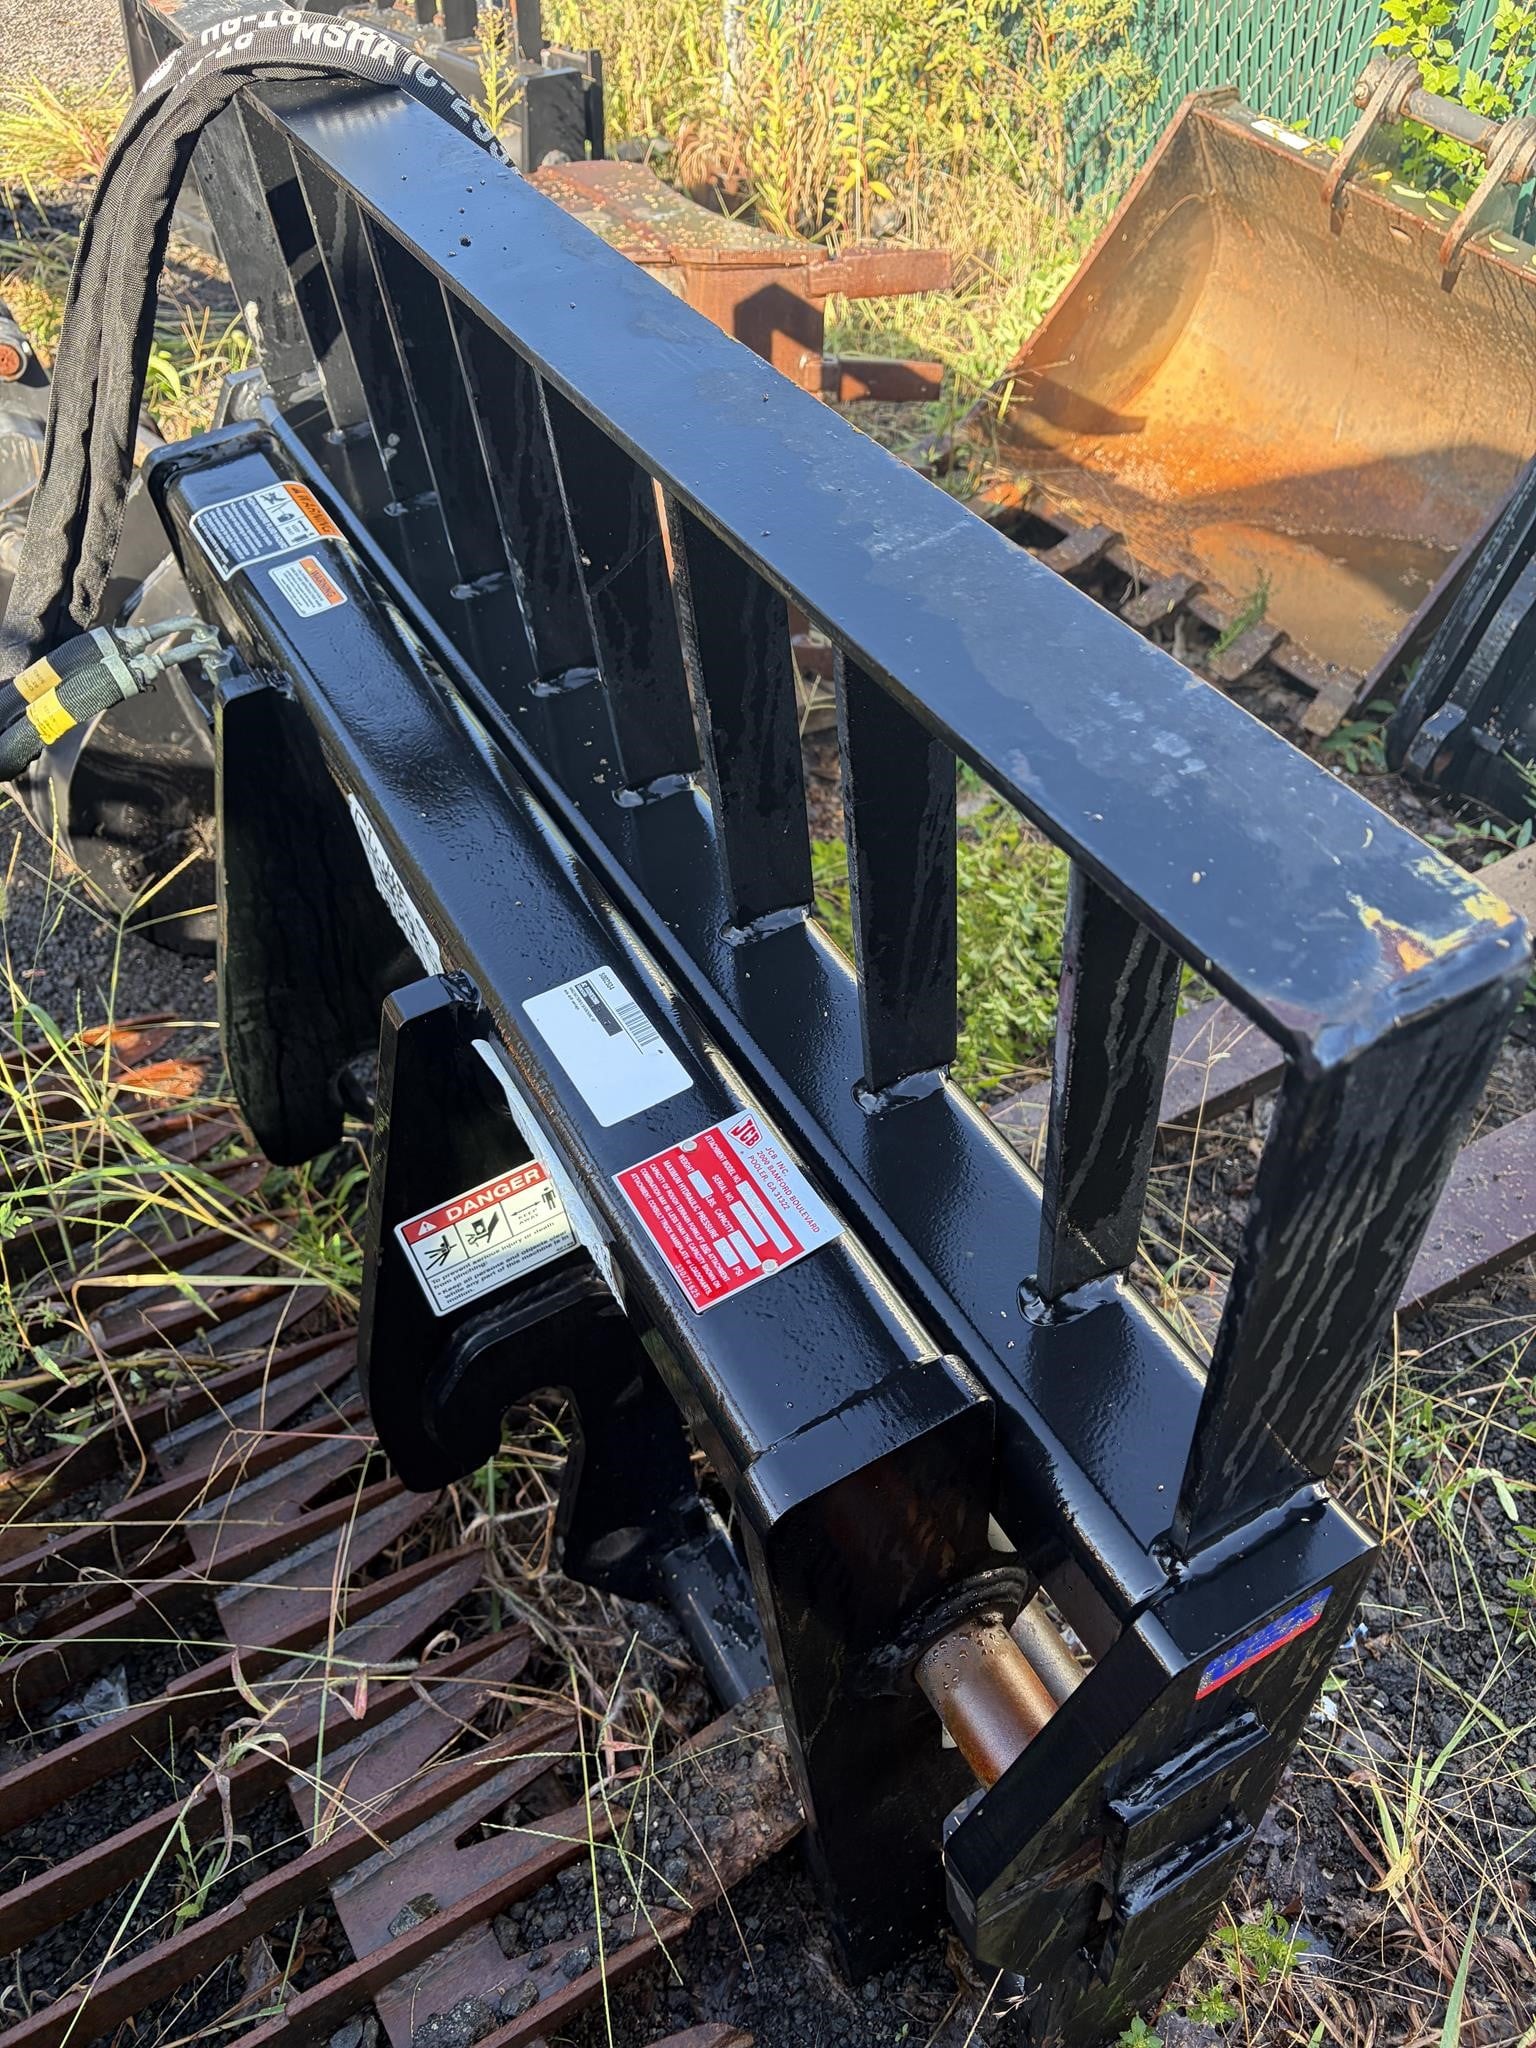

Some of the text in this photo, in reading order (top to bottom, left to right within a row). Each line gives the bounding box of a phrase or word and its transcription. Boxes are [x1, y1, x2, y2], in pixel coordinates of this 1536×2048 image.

[292, 22, 397, 64] MSHA
[311, 570, 337, 597] WARNING
[730, 1117, 760, 1148] JCB
[677, 1153, 694, 1173] WEIGHT
[703, 1134, 742, 1183] ATTACHMENT MODEL NO.
[764, 1146, 790, 1176] JCB INC.
[444, 1167, 542, 1221] DANGER
[661, 1159, 683, 1184] MAXIMUM
[677, 1182, 701, 1212] HYDRAULIC
[695, 1210, 719, 1239] PRESSURE
[711, 1173, 735, 1203] SERIAL NO.
[756, 1150, 819, 1233] 2000 BAMFORD BOULEVARD
[766, 1181, 777, 1192] GA
[773, 1191, 790, 1210] 31322
[713, 1207, 735, 1233] CAPACITY
[732, 1265, 743, 1277] PSI
